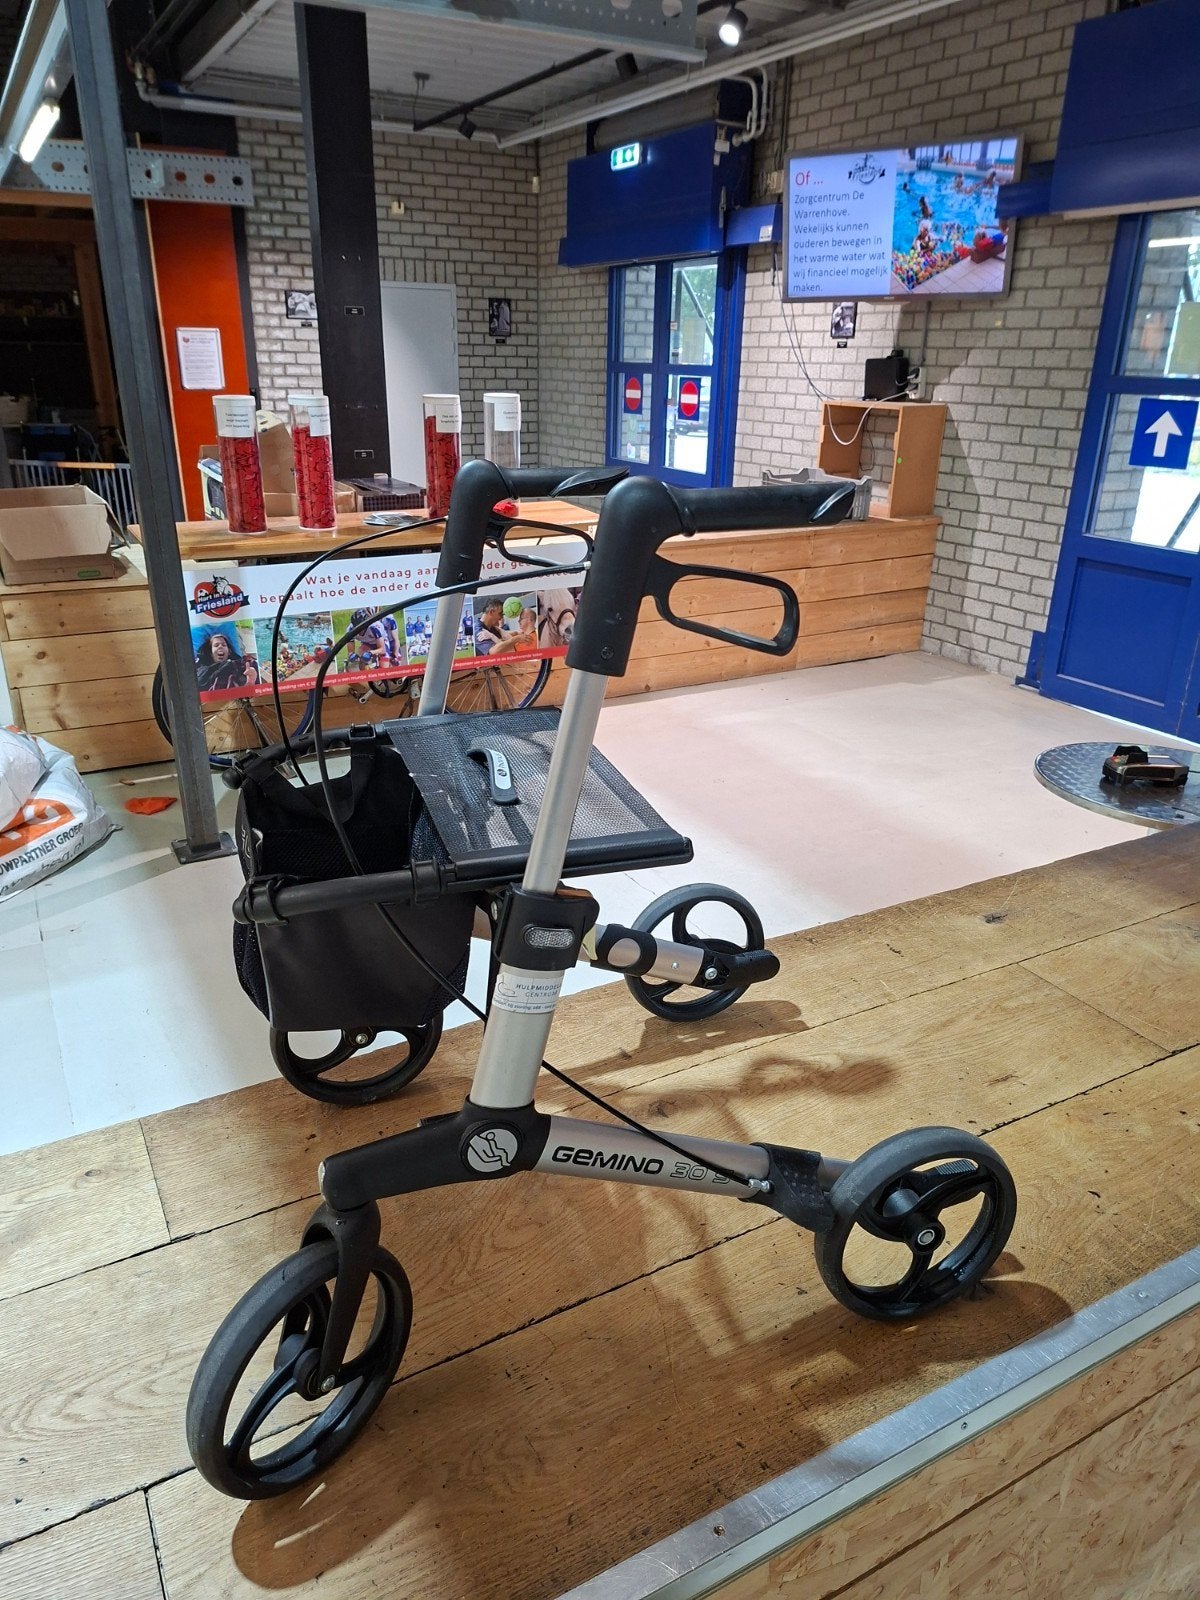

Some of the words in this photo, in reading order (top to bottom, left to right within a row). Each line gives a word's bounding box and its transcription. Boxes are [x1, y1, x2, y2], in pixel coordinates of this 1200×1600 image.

[795, 170, 811, 186] Of
[794, 192, 850, 206] Zorgcentrum
[852, 190, 865, 200] De
[794, 208, 850, 219] Warrenhove.
[794, 223, 834, 235] Wekelijks
[836, 222, 869, 231] kunnen
[793, 239, 829, 249] ouderen
[832, 237, 871, 248] bewegen
[873, 235, 882, 244] in
[793, 254, 808, 263] het
[809, 255, 839, 263] warme
[841, 253, 866, 261] water
[868, 251, 885, 260] wat
[793, 270, 806, 279] wij
[807, 267, 848, 277] financieel
[850, 266, 888, 278] mogelijk
[793, 283, 823, 292] maken.
[305, 575, 333, 586] Wat
[337, 572, 350, 584] je
[356, 568, 411, 581] vandaag
[320, 587, 344, 598] hoe
[350, 585, 366, 595] de
[371, 582, 409, 594] ander
[414, 579, 429, 589] de
[196, 593, 243, 613] Friesland
[670, 1161, 708, 1181] 30
